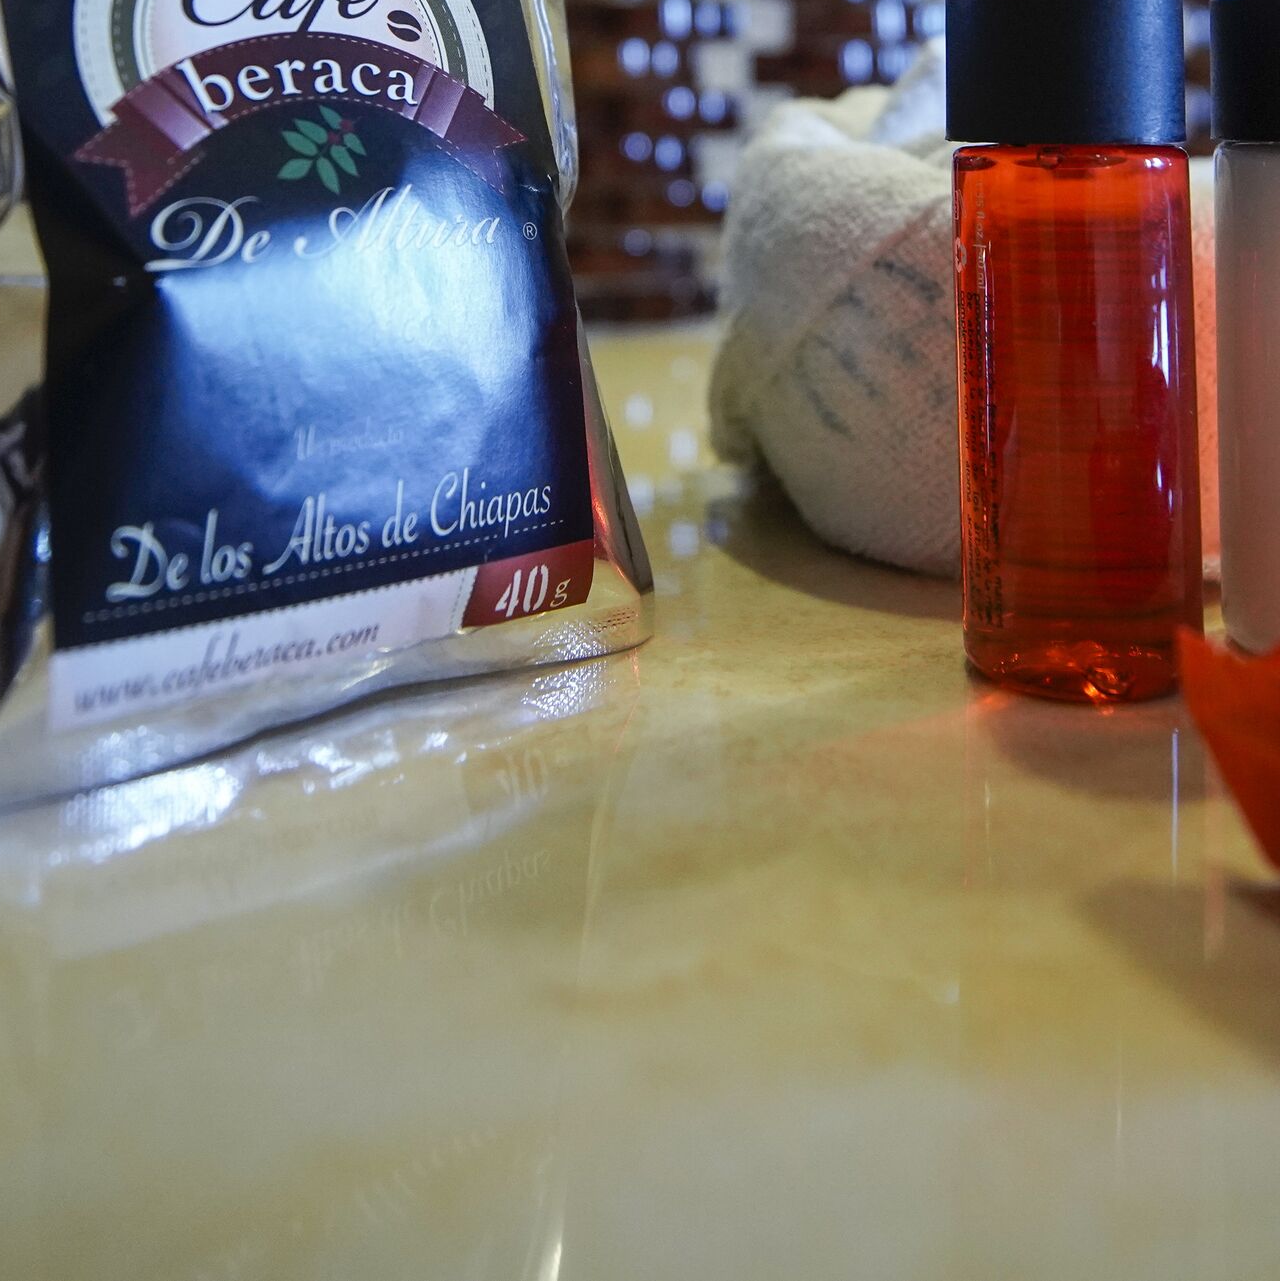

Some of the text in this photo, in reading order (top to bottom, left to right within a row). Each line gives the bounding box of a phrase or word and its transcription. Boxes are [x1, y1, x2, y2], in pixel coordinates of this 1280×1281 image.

[177, 57, 419, 115] beraca
[143, 183, 501, 271] De Altura
[105, 466, 552, 604] De los Altos de Chiapas
[494, 564, 571, 619] 40 g
